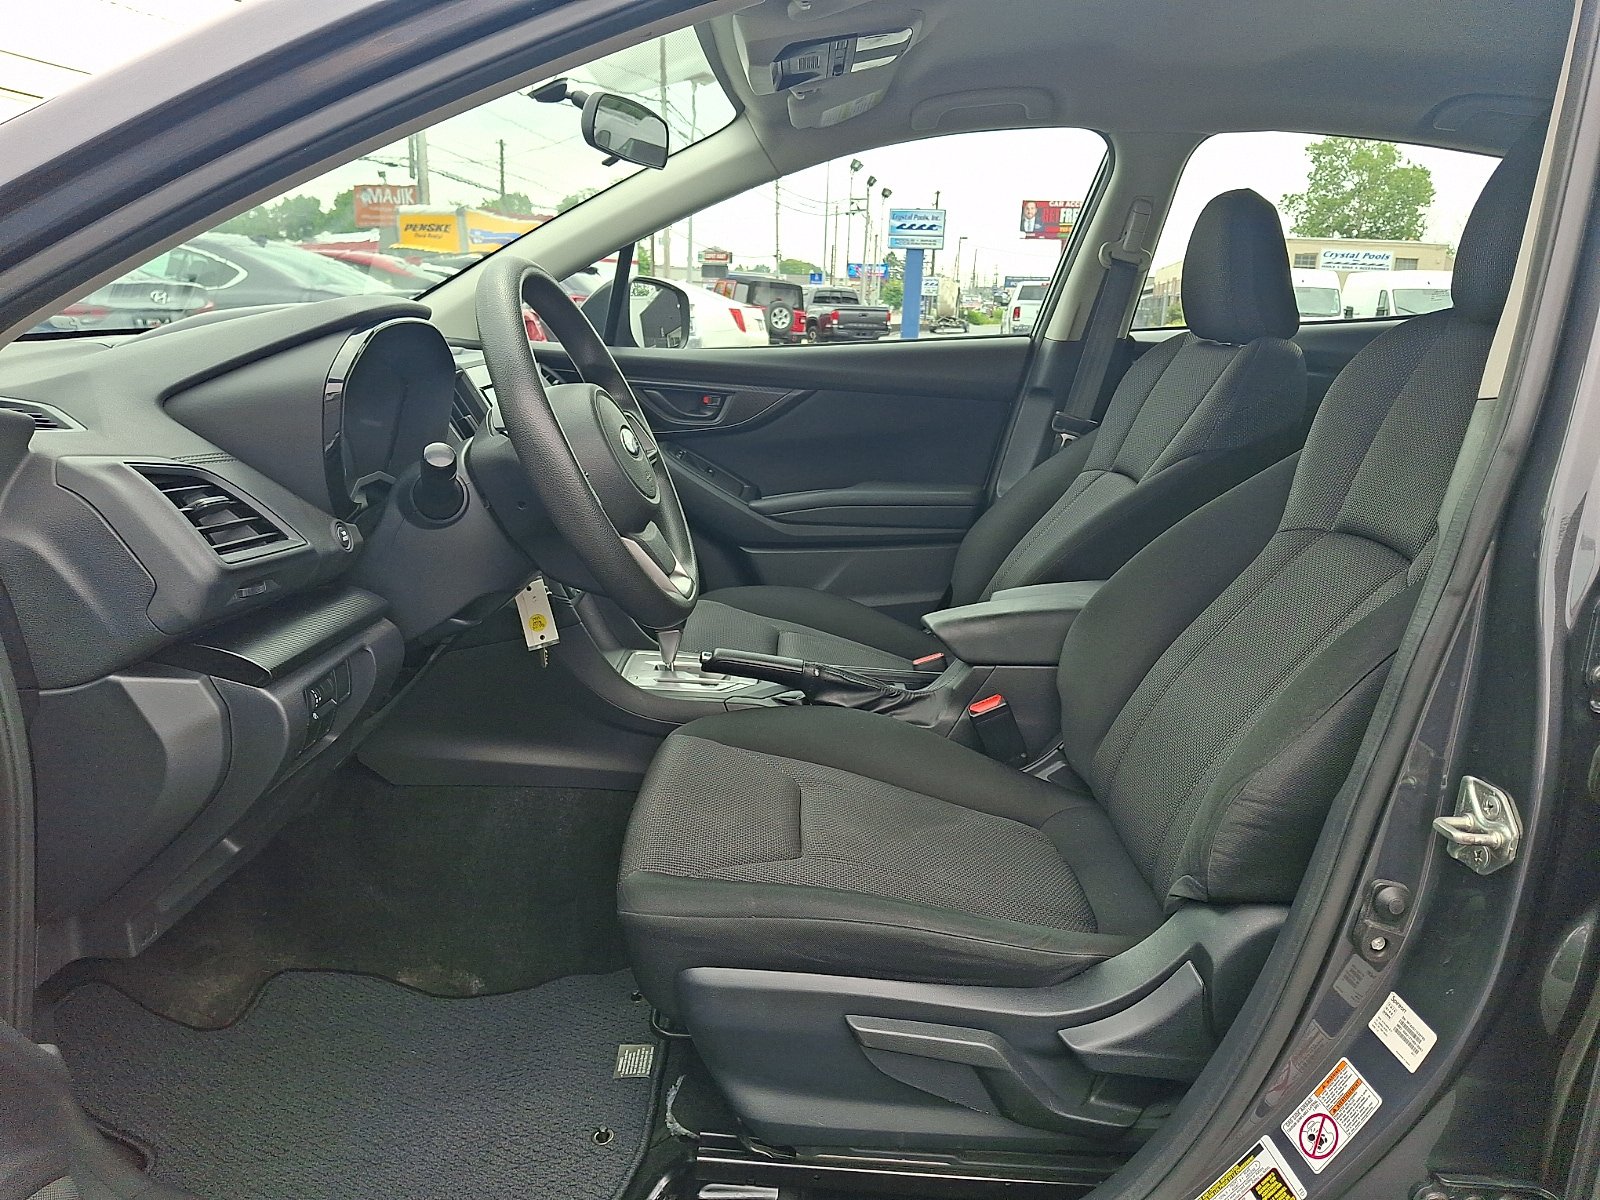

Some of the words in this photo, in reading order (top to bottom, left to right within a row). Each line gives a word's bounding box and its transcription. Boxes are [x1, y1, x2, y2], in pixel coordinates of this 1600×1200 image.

[367, 188, 415, 205] MAJIK
[404, 223, 451, 233] PENSKE
[1323, 251, 1360, 260] Crystal
[1362, 252, 1391, 260] Pools
